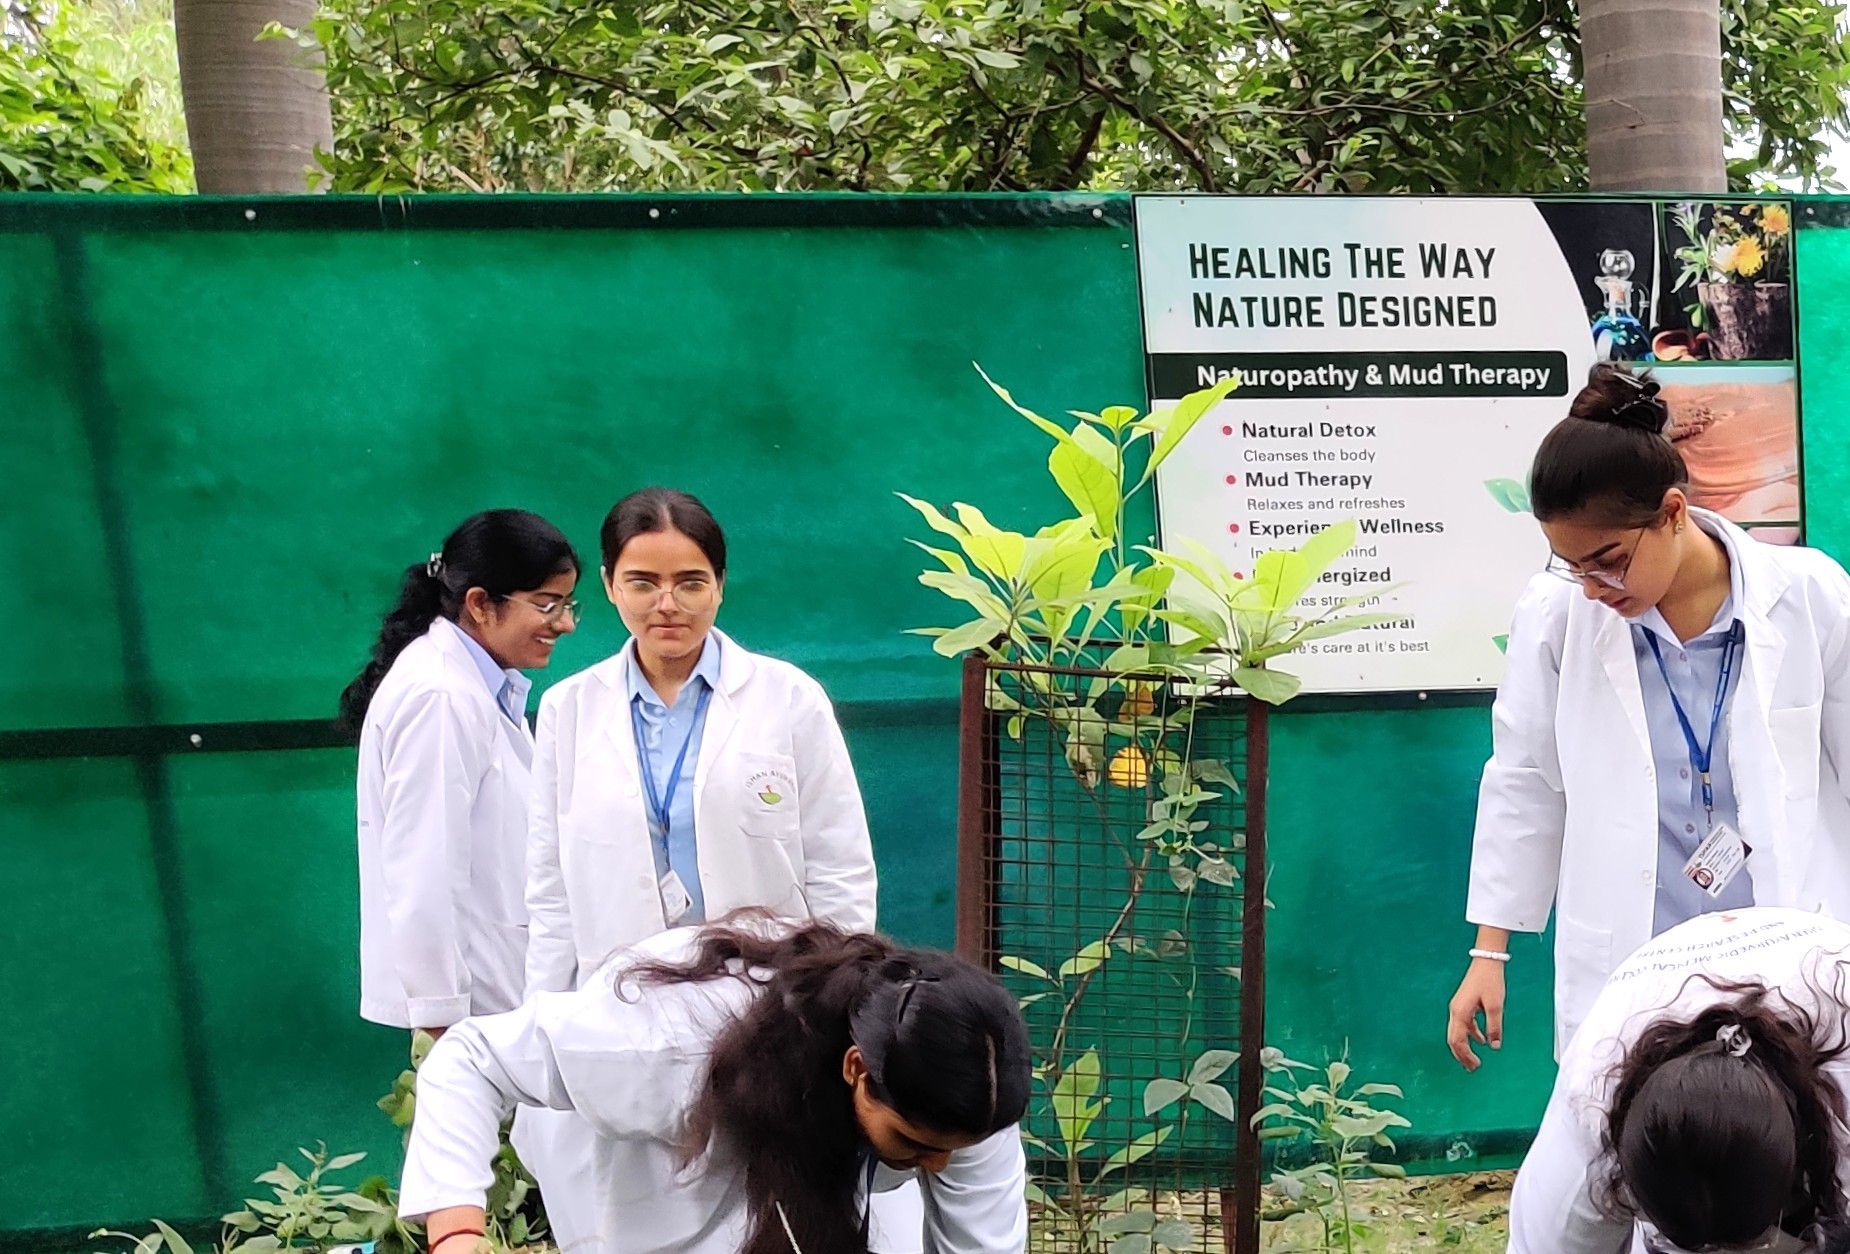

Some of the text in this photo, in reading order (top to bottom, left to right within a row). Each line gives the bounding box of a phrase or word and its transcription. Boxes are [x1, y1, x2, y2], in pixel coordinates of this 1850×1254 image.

[1188, 243, 1496, 279] HEALING THE WAY
[1192, 291, 1498, 328] NATURE DESIGNED
[1364, 364, 1384, 387] &
[1388, 363, 1444, 387] Mud
[1449, 363, 1551, 390] Therapy
[1242, 421, 1377, 438] Natural Detox
[1243, 448, 1376, 463] Cleanses the body
[1245, 471, 1373, 490] Mud Therapy
[1247, 497, 1406, 511] Relaxes and refreshes
[1249, 518, 1445, 539] Experien Wellness
[1323, 643, 1353, 654] care
[1357, 642, 1371, 653] at
[1375, 641, 1396, 653] it's
[1400, 640, 1430, 652] best
